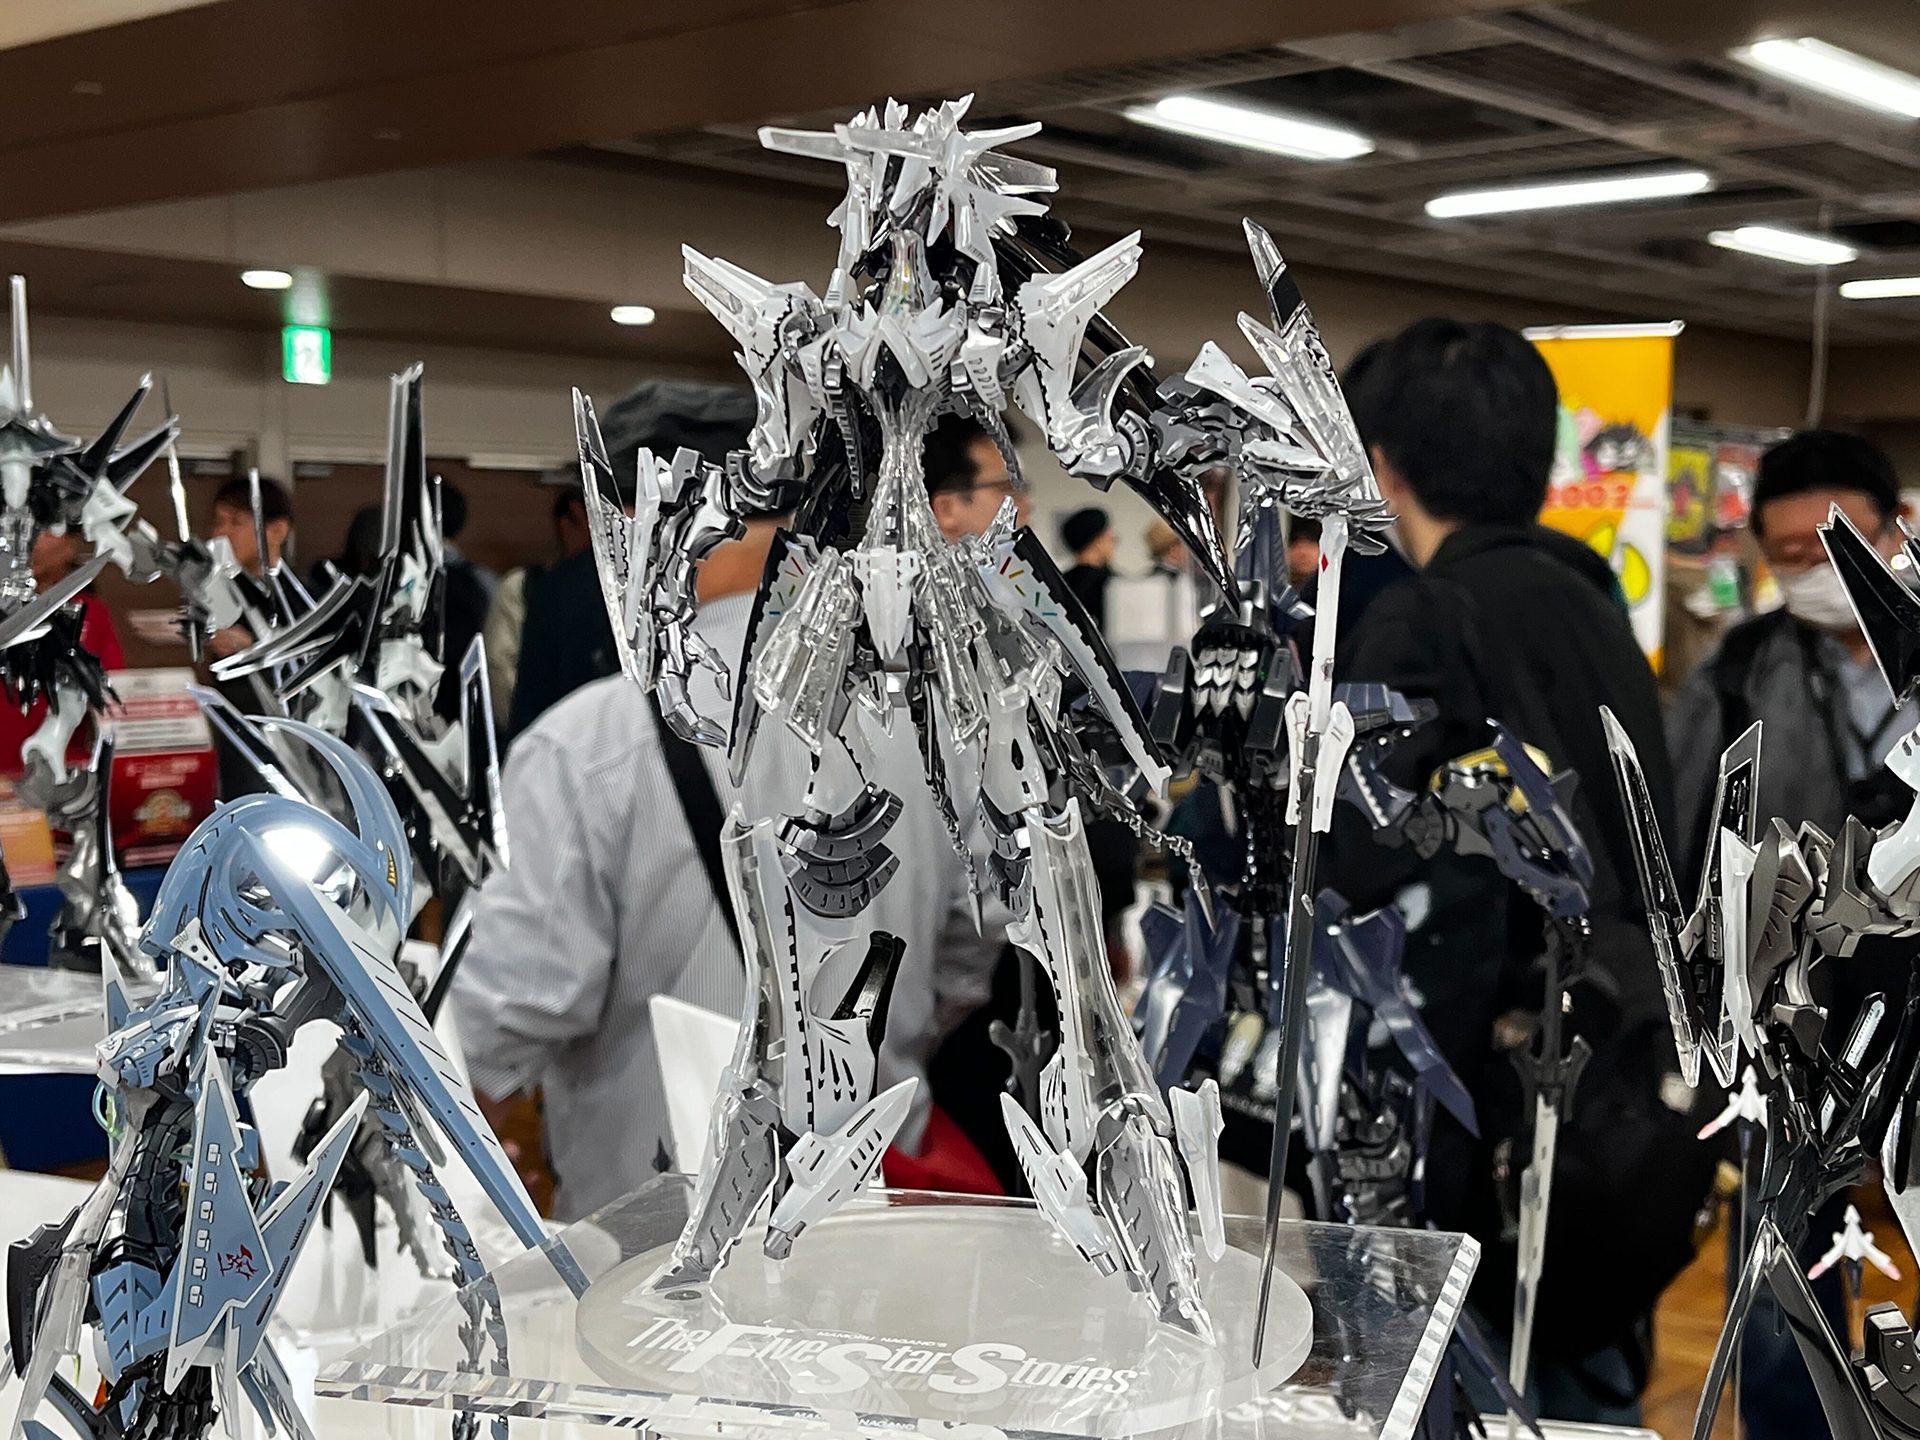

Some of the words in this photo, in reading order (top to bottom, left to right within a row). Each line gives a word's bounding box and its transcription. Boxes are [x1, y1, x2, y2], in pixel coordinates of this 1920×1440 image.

[626, 1316, 712, 1352] The
[666, 1323, 829, 1373] Five
[788, 1342, 952, 1395] Star
[927, 1342, 1139, 1394] Stories
